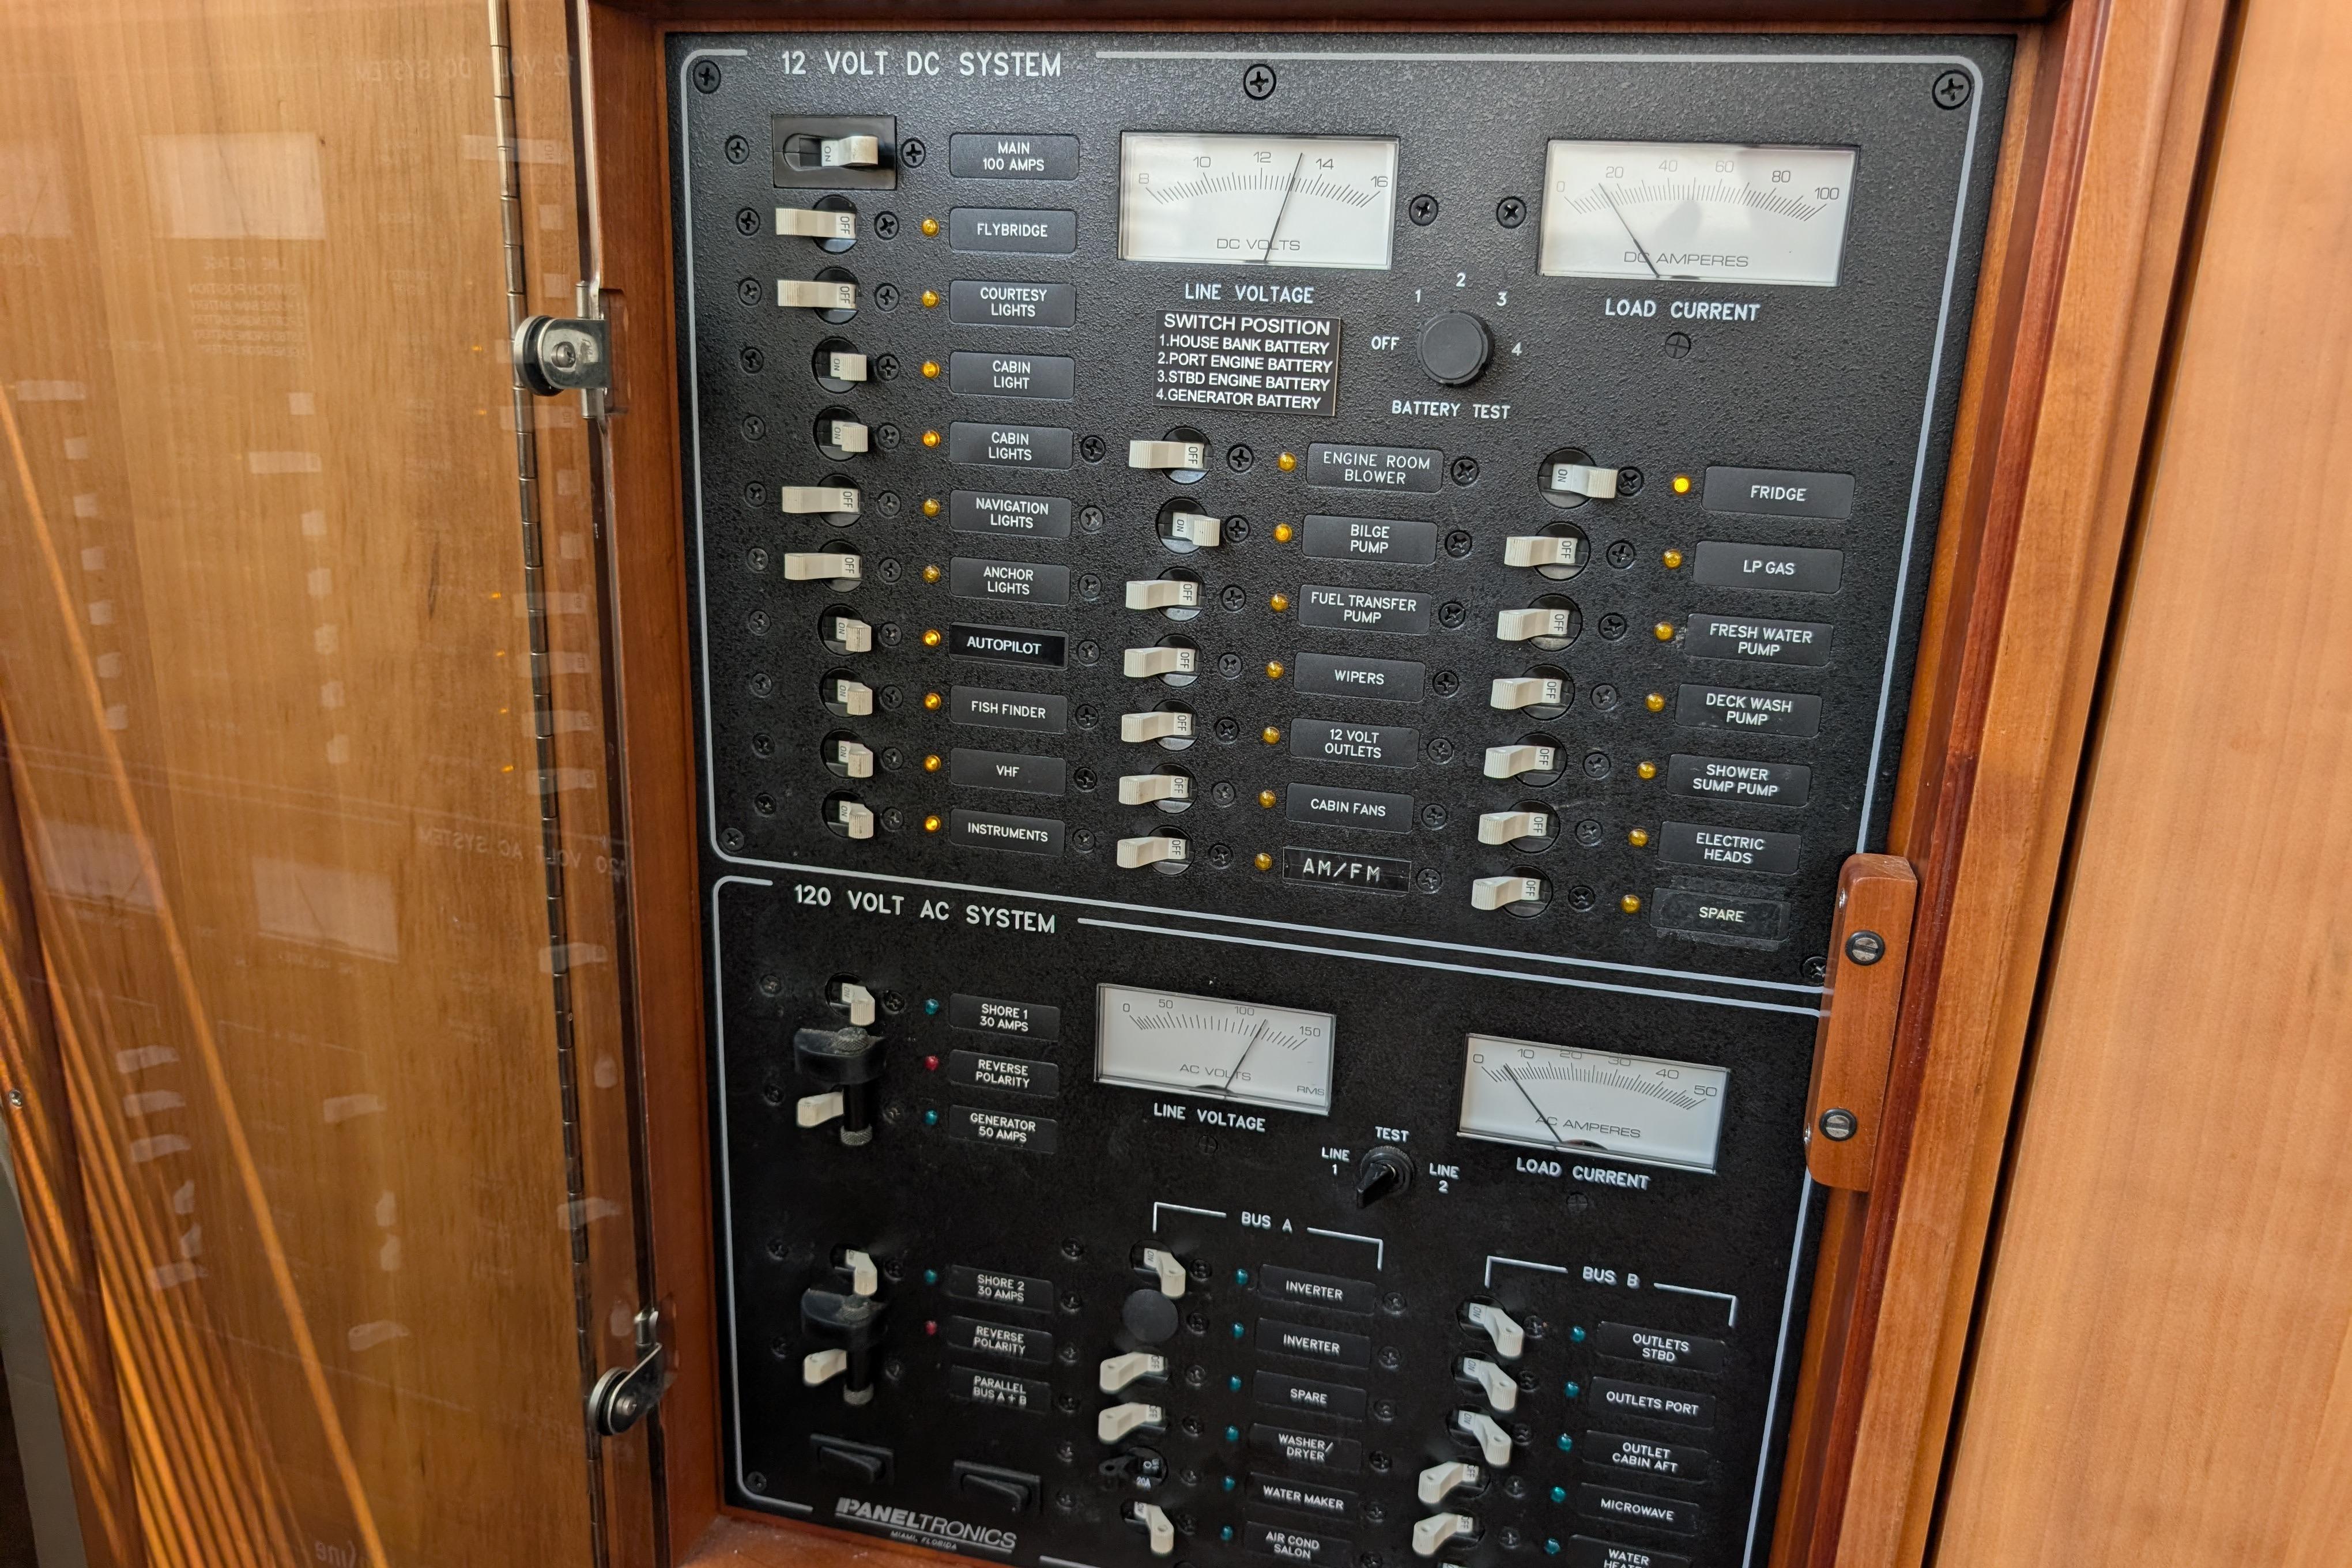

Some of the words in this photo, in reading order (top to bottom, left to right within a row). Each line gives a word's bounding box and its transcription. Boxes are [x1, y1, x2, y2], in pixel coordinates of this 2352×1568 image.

[782, 50, 806, 75] 12
[824, 51, 888, 76] VOLT
[907, 51, 940, 76] DC
[959, 51, 1061, 77] SYSTEM
[998, 141, 1030, 154] MAIN
[983, 157, 1004, 171] 100
[1009, 158, 1045, 171] AMPS
[1193, 156, 1211, 168] 10
[1253, 151, 1272, 163] 12
[1316, 158, 1334, 170] 14
[1370, 176, 1388, 187] 16
[1771, 170, 1791, 183] 80
[1814, 187, 1840, 200] 100
[977, 223, 1048, 238] FLYBRIDGE
[1216, 238, 1240, 250] DC
[1246, 239, 1300, 251] VOLTS
[1656, 253, 1748, 267] AMPERES
[1456, 272, 1466, 287] 2
[980, 287, 1047, 301] COURTESY
[1185, 283, 1222, 300] LINE
[1235, 284, 1314, 304] VOLTAGE
[1415, 289, 1421, 303] 1
[1496, 292, 1507, 307] 3
[991, 303, 1035, 317] LIGHTS
[1605, 298, 1656, 317] LOAD
[1670, 301, 1761, 321] CURRENT
[1164, 313, 1236, 331] SWITCH
[1241, 317, 1330, 336] POSITION
[1159, 334, 1219, 349] 1.HOUSE
[1223, 337, 1261, 352] BANK
[1264, 340, 1330, 355] BATTERY
[1371, 336, 1400, 350] OFF
[1511, 342, 1522, 356] 4
[992, 360, 1031, 374] CABIN
[1158, 351, 1208, 367] 2.PORT
[1211, 355, 1264, 370] ENGINE
[1268, 357, 1333, 374] BATTERY
[994, 375, 1030, 390] LIGHT
[1157, 370, 1205, 385] 3.STBD
[1208, 372, 1262, 388] ENGINE
[1265, 376, 1330, 392] BATTERY
[1156, 387, 1253, 406] 4.GENERATOR
[1257, 394, 1321, 410] BATTERY
[1392, 399, 1461, 417] BATTERY
[1472, 404, 1511, 420] TEST
[991, 431, 1029, 445] CABIN
[989, 446, 1032, 461] LIGHTS
[1324, 451, 1378, 467] ENGINE
[1386, 455, 1430, 470] ROOM
[1344, 469, 1406, 485] BLOWER
[1750, 485, 1807, 502] FRIDGE
[976, 497, 1049, 515] NAVIGATION
[990, 514, 1034, 529] LIGHTS
[1350, 524, 1390, 538] BILGE
[1350, 540, 1389, 554] PUMP
[983, 566, 1034, 581] ANCHOR
[1743, 560, 1762, 573] LP
[1765, 561, 1795, 575] GAS
[987, 581, 1030, 595] LIGHTS
[1311, 591, 1345, 606] FUEL
[1348, 594, 1416, 612] TRANSFER
[1344, 609, 1382, 624] PUMP
[1710, 623, 1758, 639] FRESH
[1763, 627, 1812, 644] WATER
[967, 636, 1042, 655] AUTOPILOT
[1737, 641, 1780, 657] PUMP
[1335, 669, 1385, 685] WIPERS
[971, 700, 998, 714] FISH
[1002, 703, 1046, 719] FINDER
[1706, 693, 1747, 708] DECK
[1750, 697, 1792, 713] WASH
[1726, 710, 1768, 726] PUMP
[1329, 729, 1343, 740] 12
[1346, 730, 1379, 744] VOLT
[1325, 742, 1381, 759] OUTLETS
[996, 764, 1020, 777] VHF
[1706, 764, 1769, 781] SHOWER
[1693, 778, 1734, 792] SUMP
[1737, 782, 1778, 797] PUMP
[1310, 798, 1350, 813] CABIN
[1353, 802, 1386, 817] FANS
[968, 822, 1048, 842] INSTRUMENTS
[1696, 832, 1765, 850] ELECTRIC
[1704, 848, 1752, 864] HEADS
[1303, 858, 1380, 881] AM/FM
[795, 884, 831, 906] 120
[847, 890, 904, 915] VOLT
[919, 899, 949, 921] AC
[966, 904, 1055, 934] SYSTEM
[1699, 906, 1744, 922] SPARE
[982, 1003, 1020, 1019] SHORE
[1023, 1009, 1028, 1019] 1
[1158, 998, 1173, 1009] 50
[1234, 1005, 1254, 1016] 100
[1299, 1026, 1321, 1037] 150
[980, 1015, 995, 1027] 30
[997, 1018, 1028, 1032] AMPS
[978, 1059, 1028, 1076] REVERSE
[1179, 1064, 1200, 1074] AC
[1205, 1067, 1251, 1081] VOLTS
[1517, 1048, 1535, 1059] 10
[1655, 1068, 1679, 1079] 40
[1694, 1085, 1717, 1097] 50
[976, 1071, 1030, 1088] POLARITY
[1296, 1085, 1325, 1096] RMS
[970, 1113, 1035, 1132] GENERATOR
[1154, 1102, 1186, 1120] LINE
[1197, 1109, 1265, 1132] VOLTAGE
[979, 1126, 994, 1137] 50
[996, 1129, 1027, 1143] AMPS
[1375, 1126, 1409, 1142] TEST
[1563, 1119, 1641, 1138] AMPERES
[1321, 1147, 1350, 1162] LINE
[1332, 1164, 1337, 1174] 1
[1429, 1162, 1459, 1179] LINE
[1516, 1156, 1561, 1177] LOAD
[1572, 1165, 1649, 1189] CURRENT
[1438, 1180, 1448, 1192] 2
[1241, 1211, 1271, 1228] BUS
[1282, 1218, 1292, 1232] A
[978, 1274, 1014, 1289] SHORE
[1017, 1281, 1024, 1291] 2
[1582, 1266, 1616, 1284] BUS
[1627, 1273, 1638, 1287] B
[977, 1286, 992, 1296] 30
[994, 1289, 1024, 1302] AMPS
[1286, 1280, 1343, 1300] INVERTER
[977, 1326, 1024, 1343] REVERSE
[1633, 1333, 1690, 1353] OUTLETS
[974, 1337, 1026, 1355] POLARITY
[1283, 1334, 1340, 1354] INVERTER
[1642, 1347, 1675, 1362] STBD
[973, 1386, 995, 1399] BUS
[974, 1376, 1026, 1394] PARALLEL
[1290, 1388, 1327, 1404] SPARE
[1606, 1391, 1662, 1409] OUTLETS
[1665, 1400, 1699, 1415] PORT
[1278, 1433, 1334, 1453] WASHER/
[1622, 1442, 1671, 1460] OUTLET
[1286, 1446, 1325, 1461] DRYER
[1612, 1451, 1651, 1468] CABIN
[1654, 1460, 1678, 1472] AFT
[1263, 1485, 1301, 1502] WATER
[1304, 1493, 1344, 1510] MAKER
[1600, 1498, 1674, 1521] MICROWAVE
[1265, 1531, 1286, 1543] AIR
[1287, 1535, 1320, 1550] COND
[1274, 1543, 1311, 1559] SALON
[1608, 1548, 1649, 1568] WATER
